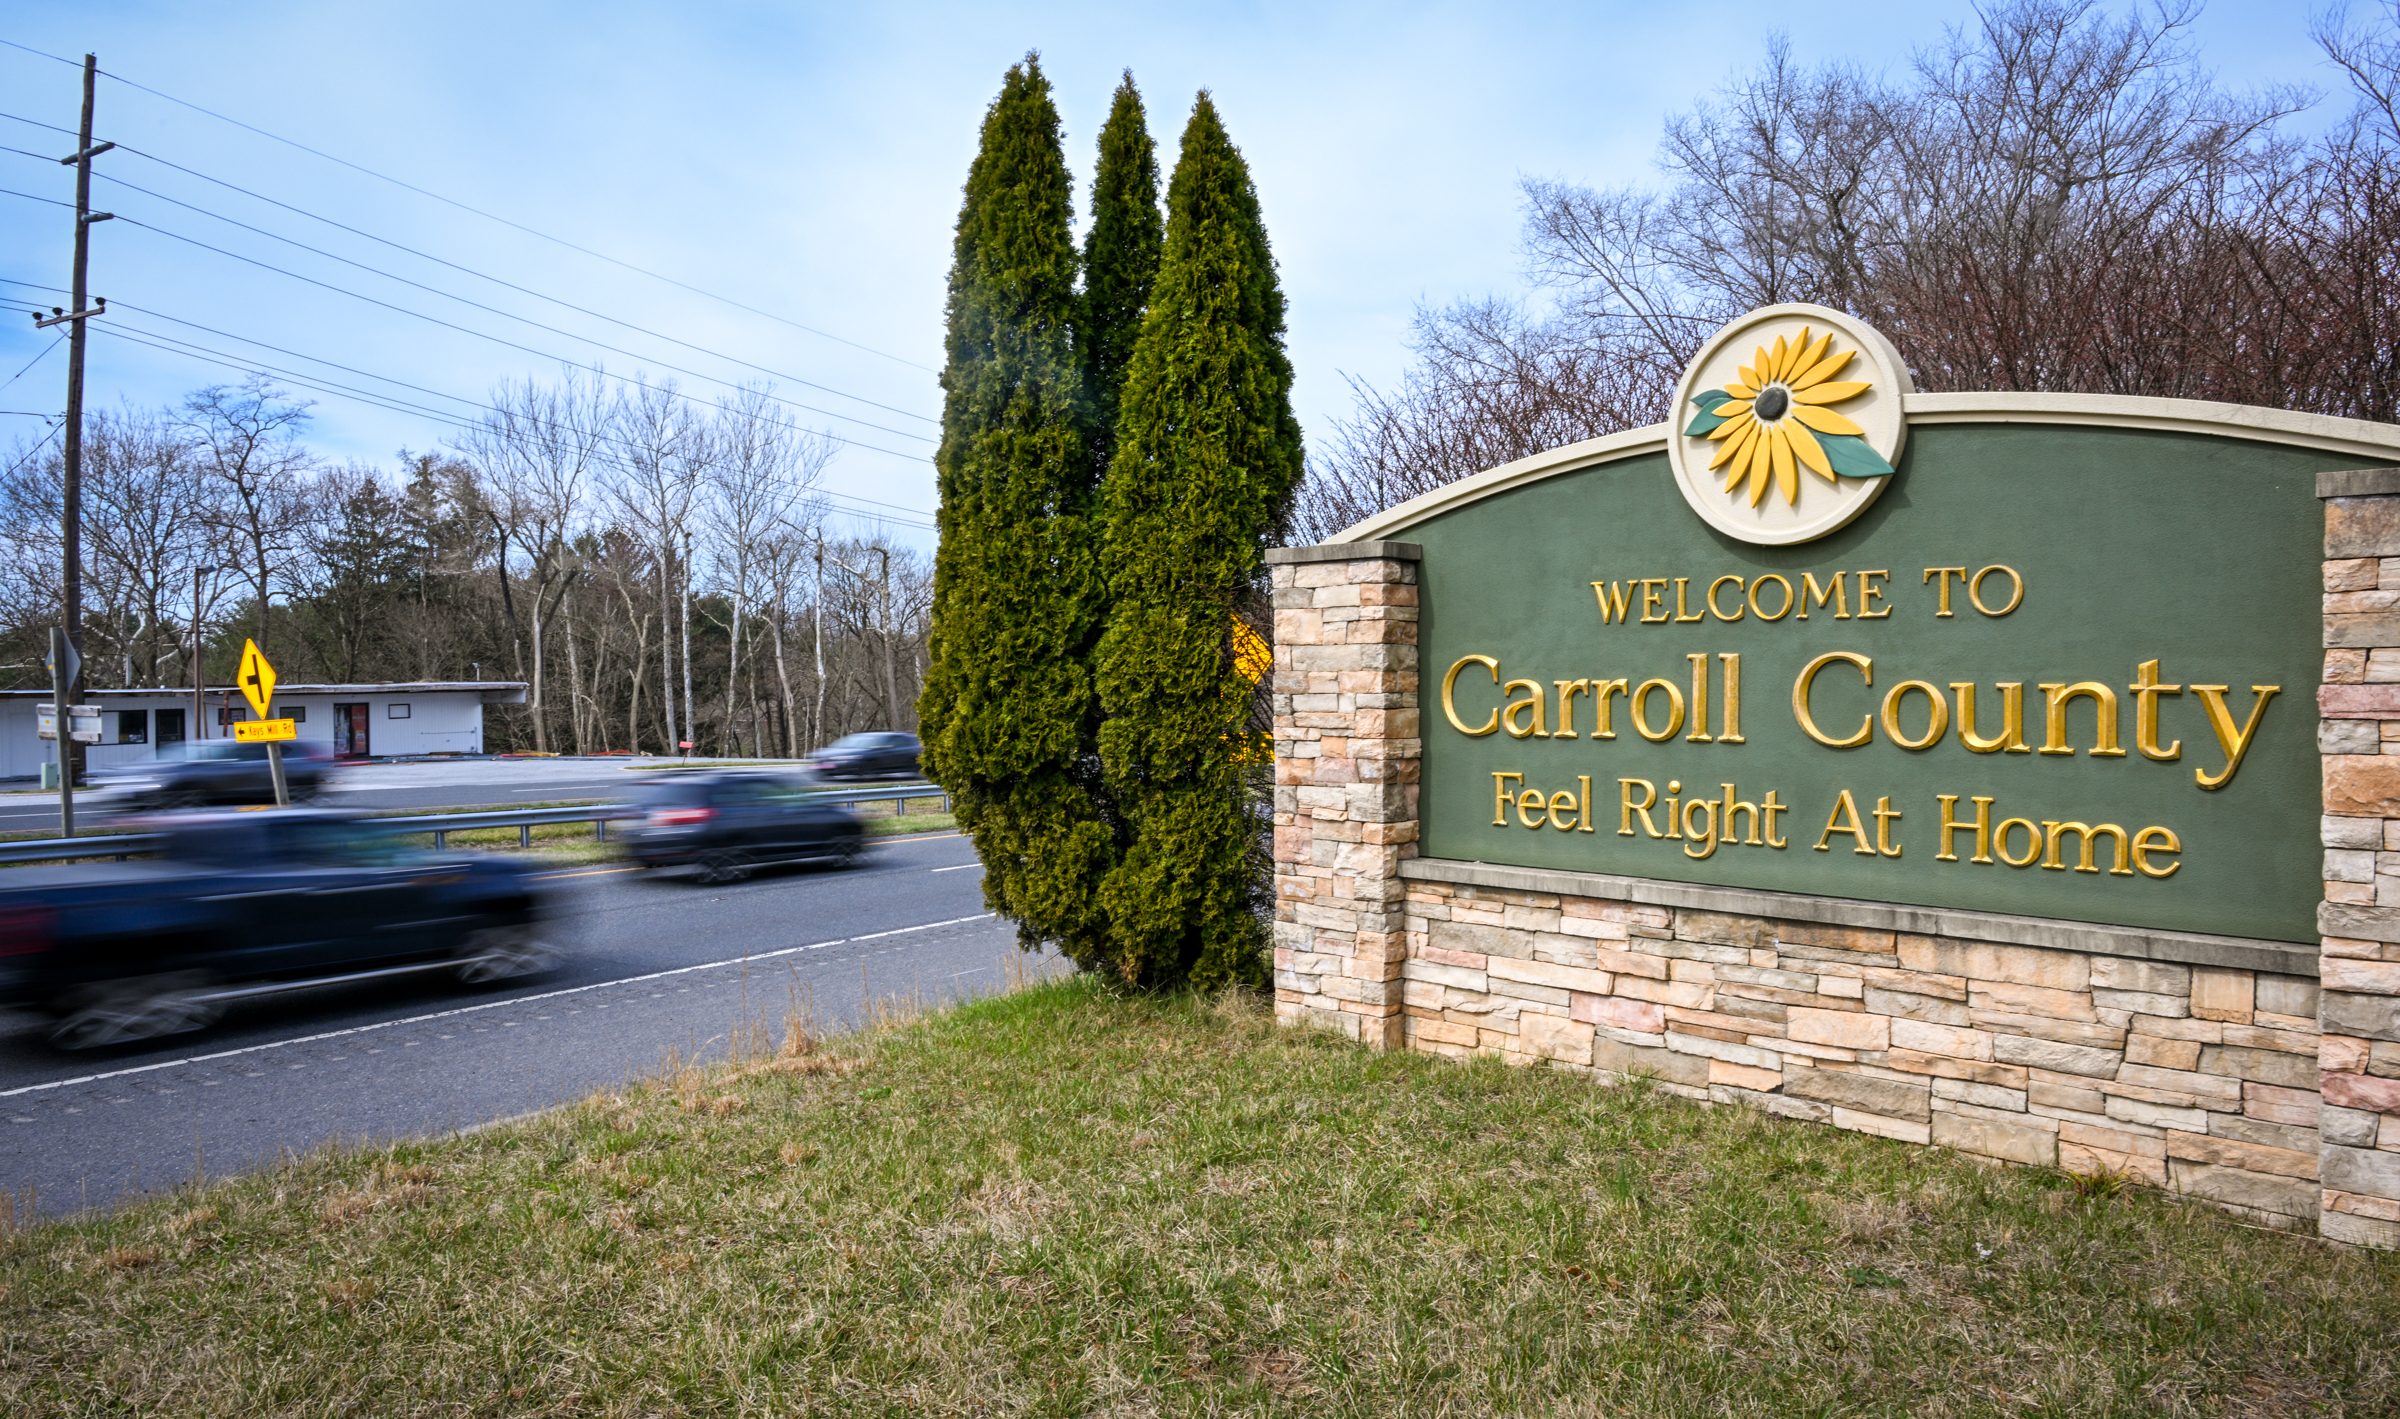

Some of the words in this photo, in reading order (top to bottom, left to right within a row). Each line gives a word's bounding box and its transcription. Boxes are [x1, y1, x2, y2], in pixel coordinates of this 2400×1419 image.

[1590, 569, 1893, 625] WELCOME
[1923, 564, 2025, 618] TO
[1440, 653, 1747, 744] Carroll
[1792, 651, 2282, 791] County
[1491, 771, 1595, 833] Feel
[1617, 777, 1789, 859] Right
[1812, 789, 1903, 858] At
[1935, 794, 2183, 878] Home
